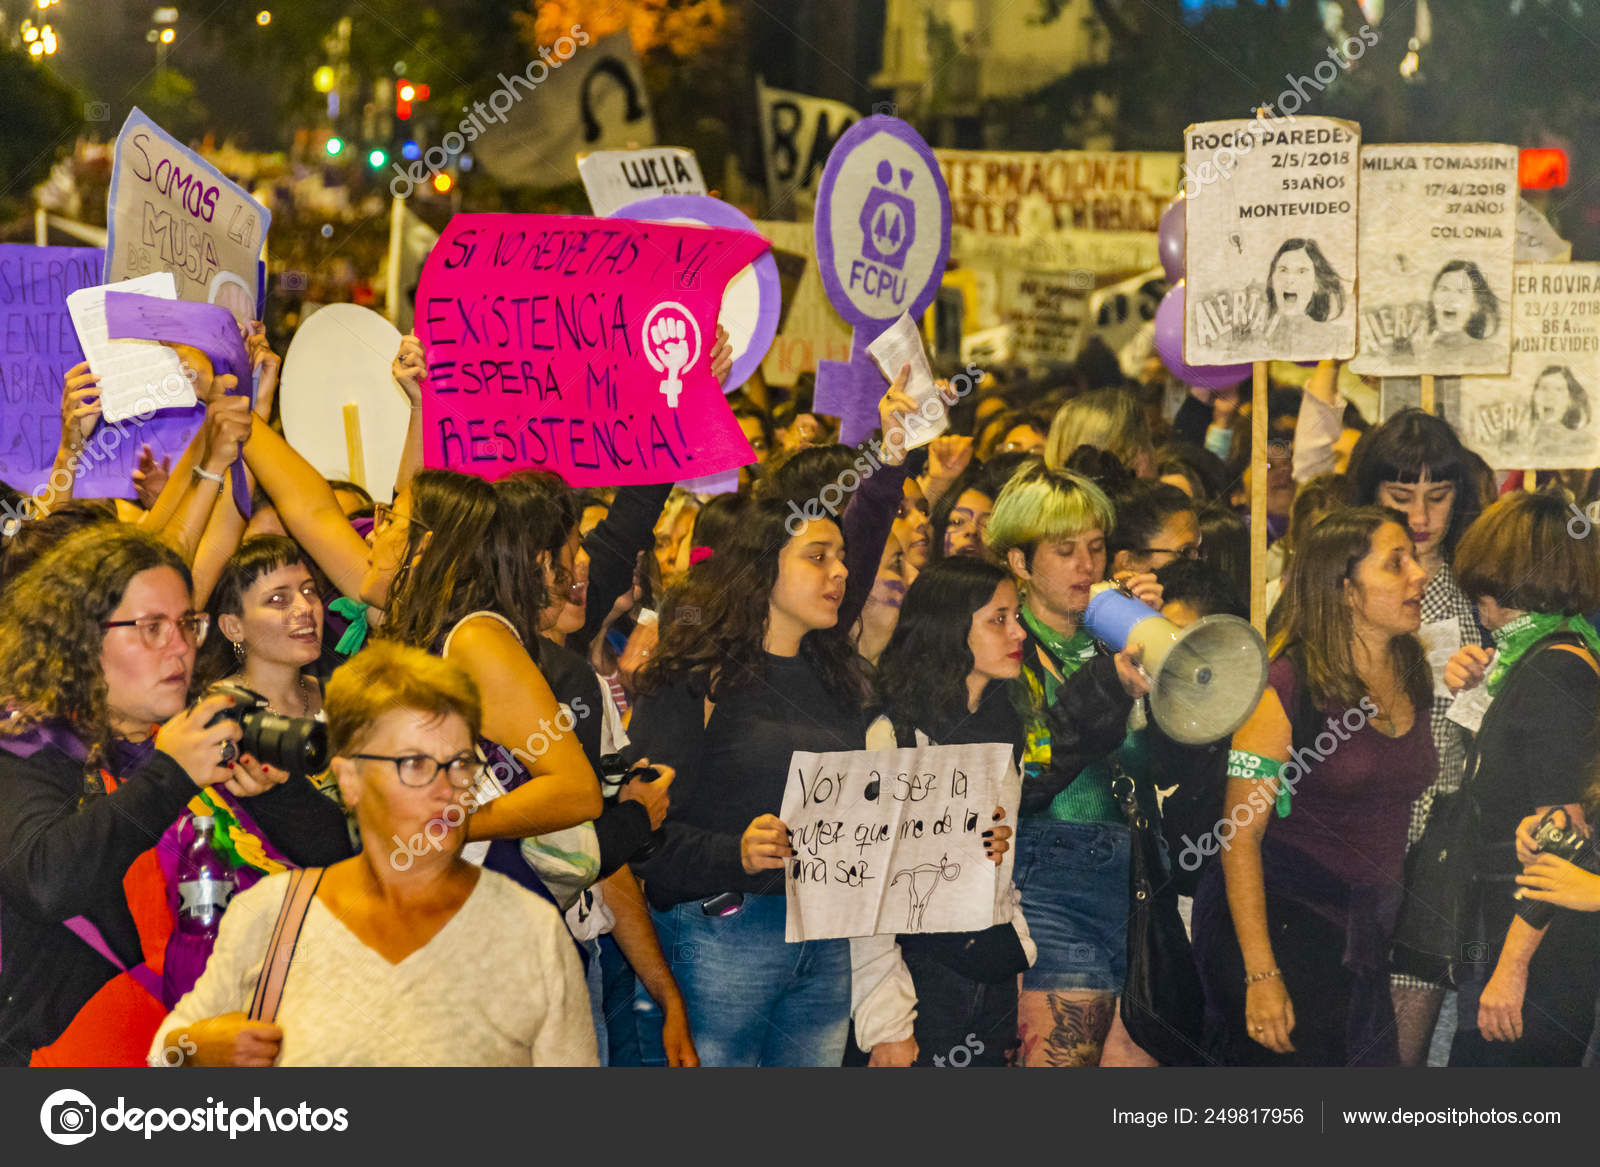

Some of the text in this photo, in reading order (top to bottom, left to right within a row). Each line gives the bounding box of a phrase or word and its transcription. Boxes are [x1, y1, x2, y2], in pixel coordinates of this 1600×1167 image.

[1271, 151, 1351, 168] 2/5/2018
[1361, 156, 1417, 172] MILKA
[132, 134, 256, 249] SOMOS LA
[1424, 182, 1507, 197] 17/4/2018
[1239, 200, 1351, 219] MONTEVIDEO
[141, 200, 220, 286] MUSA
[1430, 226, 1504, 240] COLONIA
[849, 259, 908, 306] FCPU
[864, 770, 881, 805] a
[952, 768, 968, 800] la
[854, 822, 890, 856] que
[900, 818, 924, 840] me
[963, 807, 979, 834] la
